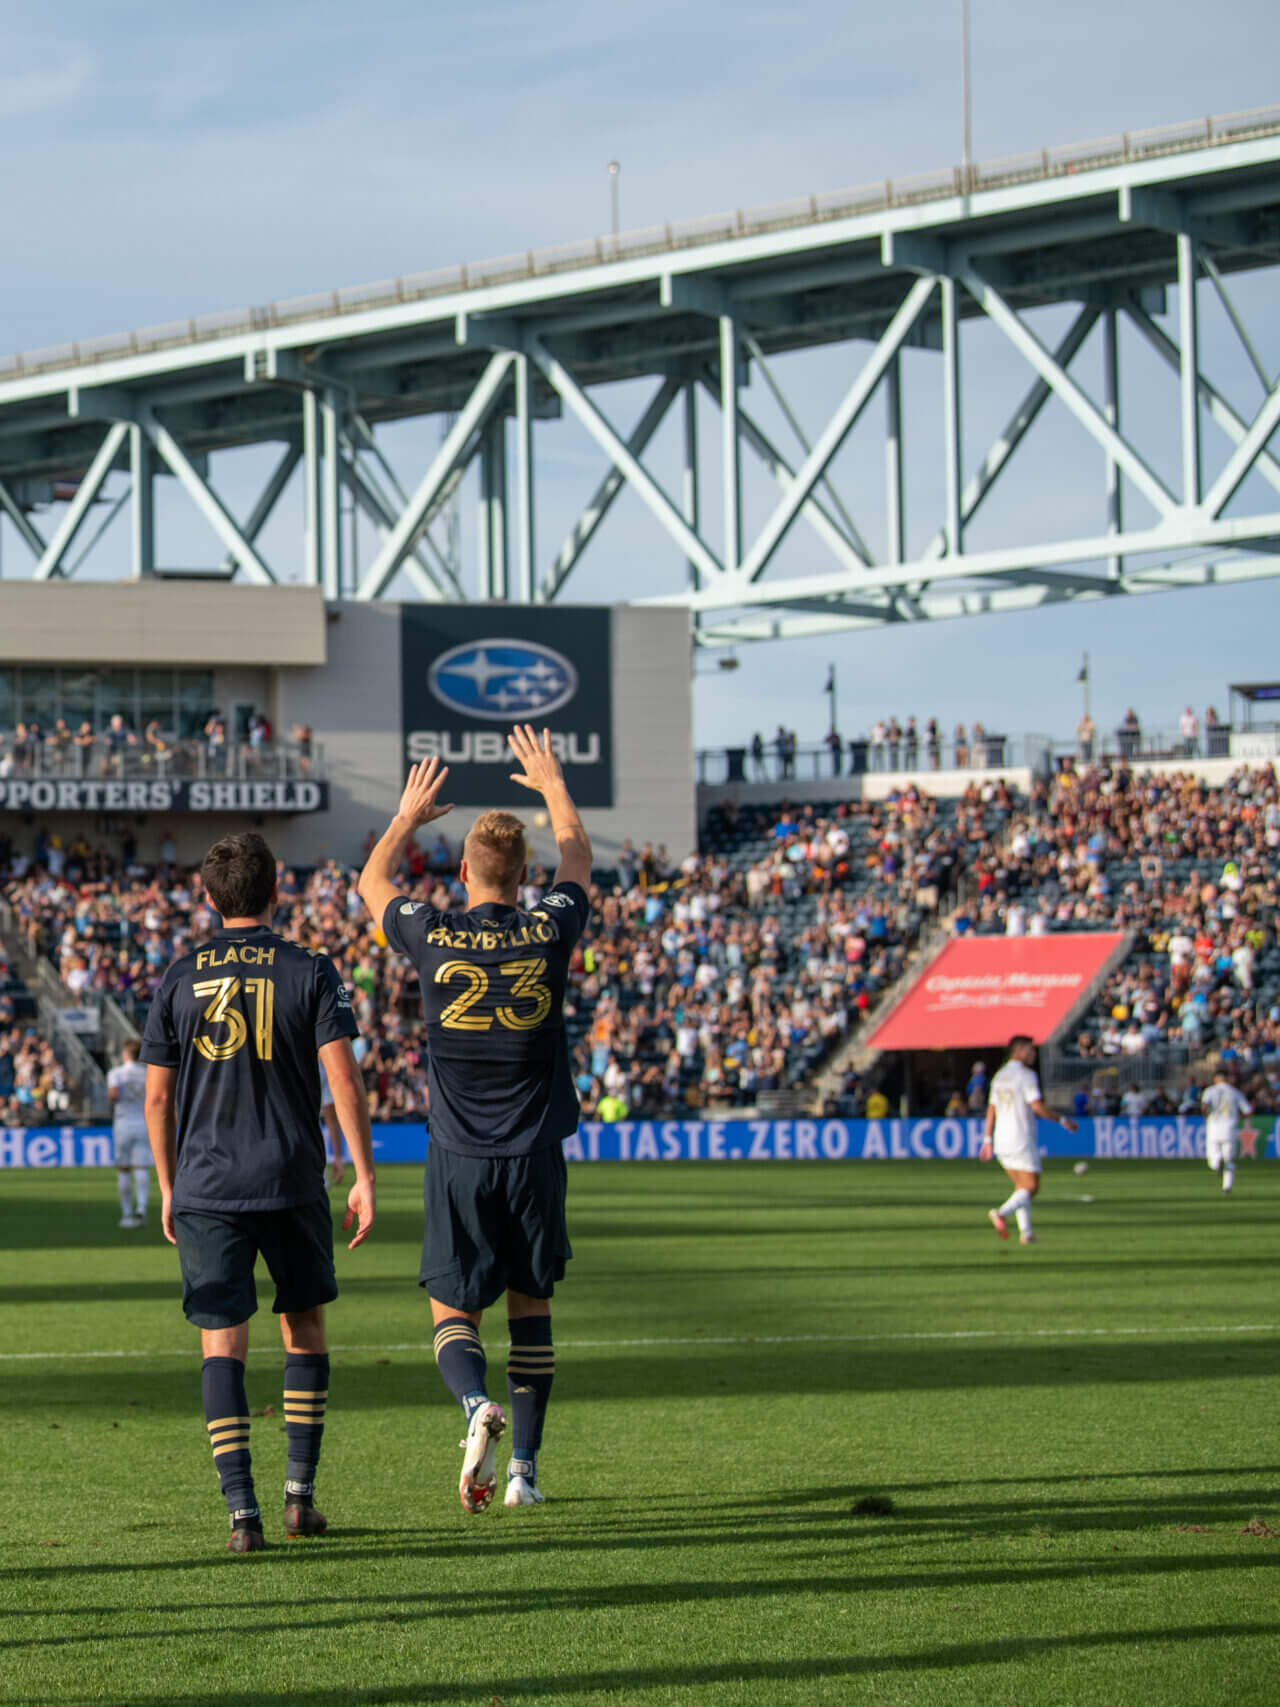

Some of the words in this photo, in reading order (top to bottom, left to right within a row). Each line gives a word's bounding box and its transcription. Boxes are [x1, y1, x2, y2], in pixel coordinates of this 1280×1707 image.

[188, 781, 320, 811] SHIELD
[196, 945, 276, 971] FLACH
[434, 957, 552, 1031] 23
[192, 976, 274, 1061] 31
[561, 1121, 604, 1160] AT
[862, 1117, 1047, 1158] ALCOH.
[1094, 1115, 1207, 1158] Heineke
